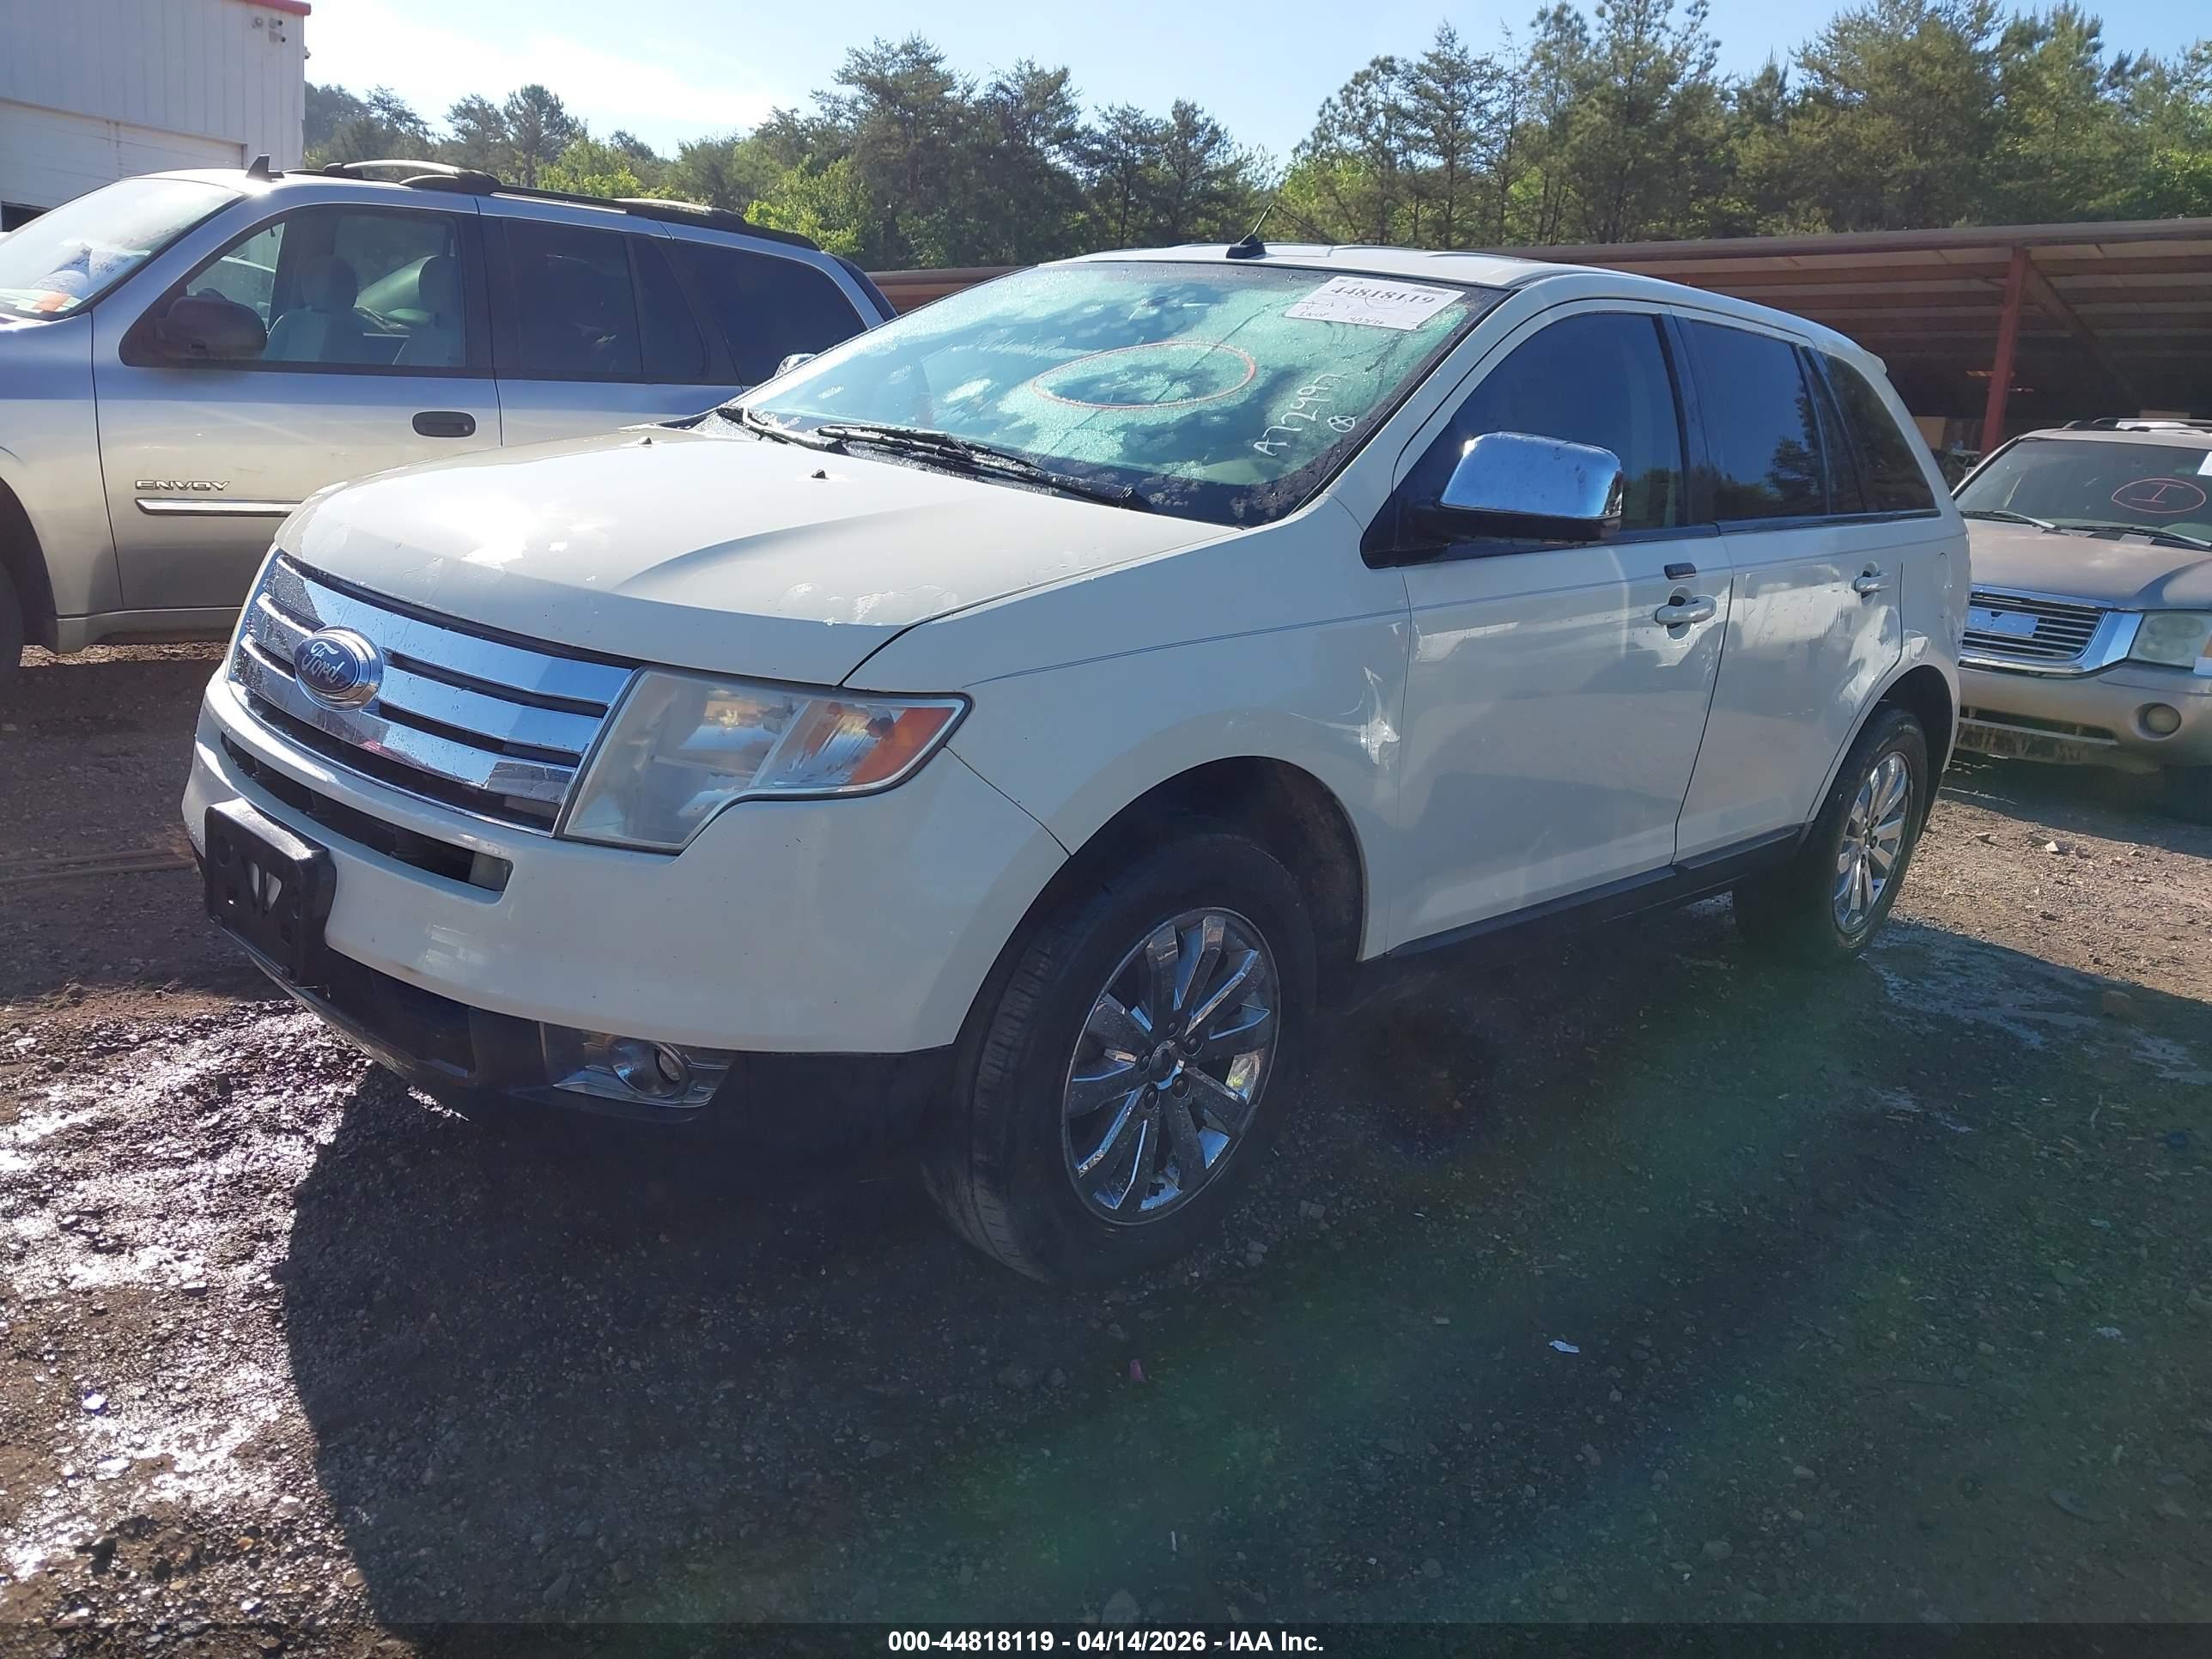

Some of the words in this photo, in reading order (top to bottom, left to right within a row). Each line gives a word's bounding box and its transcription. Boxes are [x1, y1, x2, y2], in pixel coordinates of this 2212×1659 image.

[1330, 286, 1436, 304] 44818119
[136, 480, 230, 491] ENVOY
[301, 641, 345, 684] Ford
